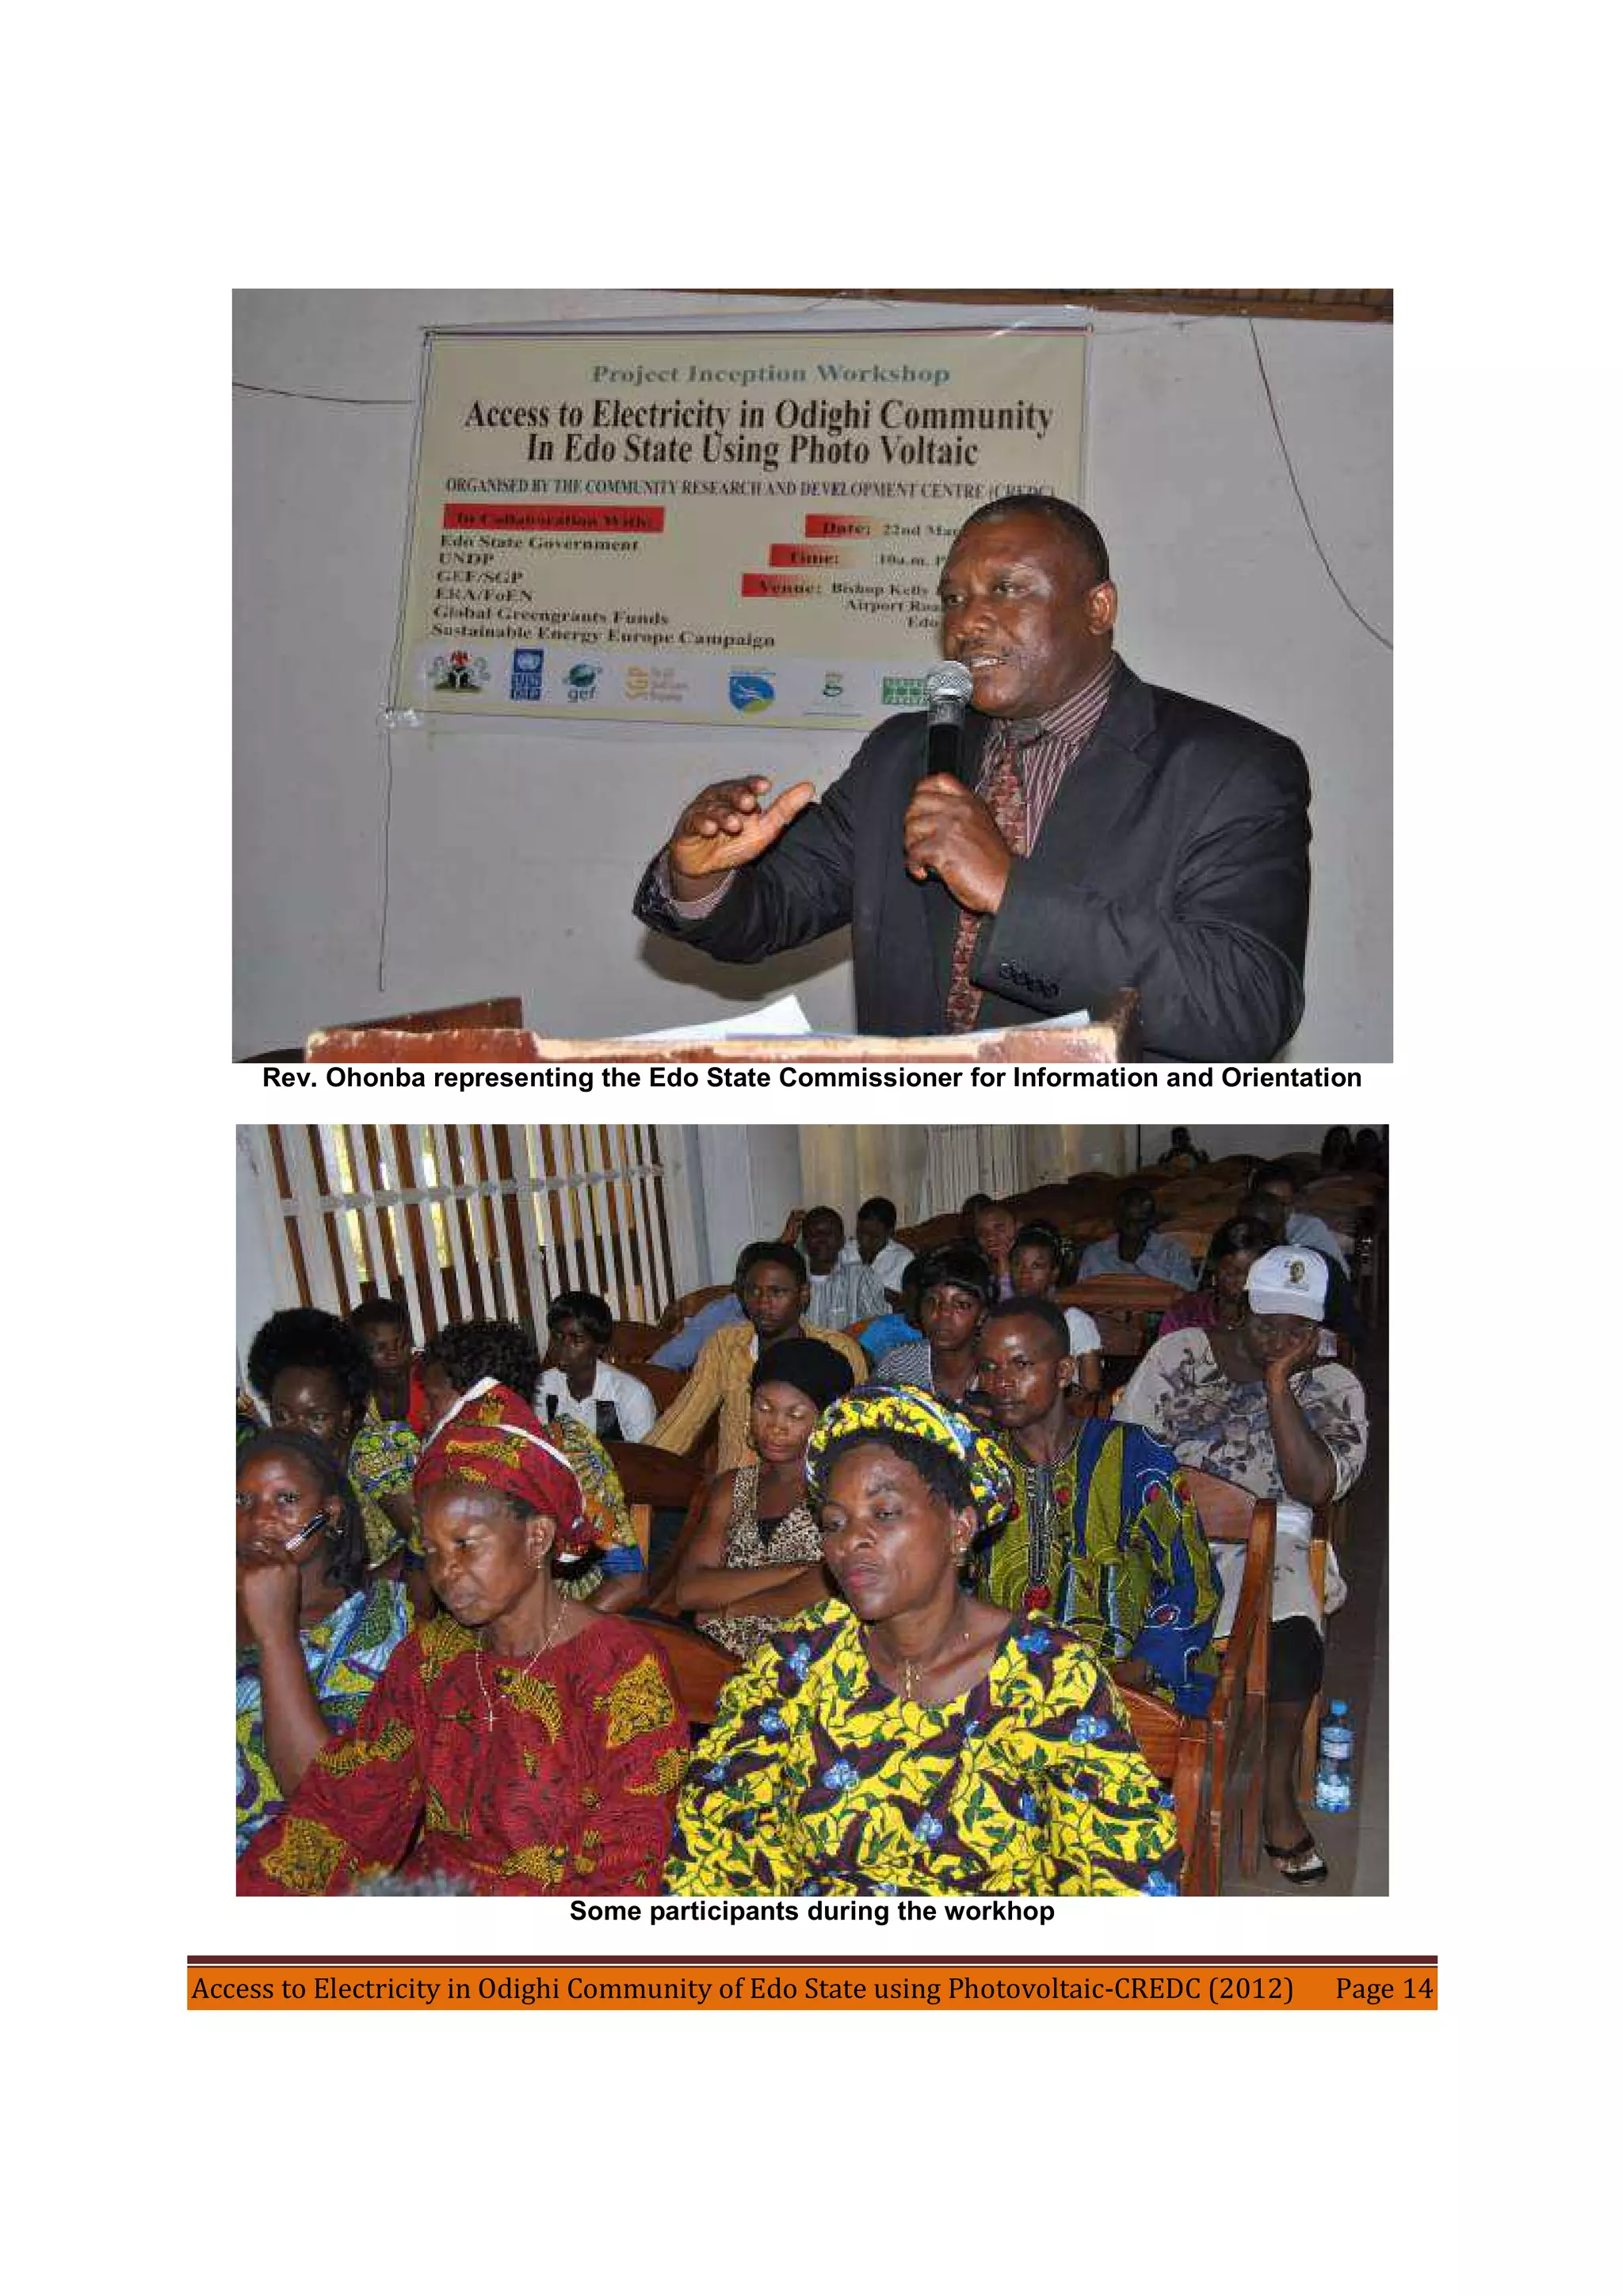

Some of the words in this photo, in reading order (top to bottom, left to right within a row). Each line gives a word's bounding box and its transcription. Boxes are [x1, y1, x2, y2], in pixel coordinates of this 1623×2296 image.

[593, 364, 678, 386] Project
[688, 364, 806, 387] Inception
[817, 364, 951, 387] Workshop
[464, 399, 548, 428] Access
[559, 401, 582, 428] to
[594, 399, 731, 435] Electricity
[739, 399, 764, 429] in
[776, 399, 870, 436] Odighi
[880, 399, 1052, 439] Community
[527, 433, 554, 460] In
[564, 433, 616, 463] Edo
[624, 433, 693, 463] State
[703, 435, 778, 471] Using
[791, 435, 869, 464] Photo
[881, 435, 980, 466] Voltaic
[445, 478, 528, 493] ORGANISED
[532, 478, 548, 493] BY
[554, 479, 582, 494] THE
[586, 479, 676, 494] COMMUNITY
[682, 480, 762, 496] RESEARCH
[764, 481, 796, 497] AND
[801, 481, 917, 499] DEVELOPMENT
[921, 482, 986, 499] CENTRE
[823, 521, 870, 536] Date:
[884, 524, 919, 536] 22nd
[441, 535, 475, 548] Edo
[478, 536, 522, 549] State
[529, 537, 639, 551] Government
[439, 552, 495, 565] UNDP
[791, 551, 840, 565] Time:
[437, 570, 524, 584] GEF/SGP
[437, 587, 533, 602] ERA/FoEN
[760, 579, 822, 594] Venue:
[832, 582, 884, 597] Bishop
[434, 606, 491, 621] Global
[498, 608, 606, 625] Greengrants
[613, 609, 669, 625] Funds
[849, 600, 903, 614] Airport
[908, 601, 943, 612] Roa
[432, 624, 529, 639] Sustainable
[538, 627, 598, 644] Energy
[608, 628, 674, 646] Europe
[679, 631, 775, 649] Campaign
[567, 686, 596, 704] gef
[263, 1066, 317, 1088] Rev.
[326, 1066, 426, 1088] Ohonba
[434, 1066, 594, 1093] representing
[601, 1066, 641, 1088] the
[650, 1066, 699, 1088] Edo
[707, 1066, 771, 1088] State
[779, 1066, 964, 1088] Commissioner
[970, 1066, 1006, 1088] for
[1014, 1066, 1158, 1088] Information
[1167, 1066, 1213, 1088] and
[1222, 1066, 1361, 1088] Orientation
[570, 1900, 641, 1920] Some
[651, 1900, 799, 1926] participants
[808, 1900, 889, 1926] during
[897, 1900, 937, 1920] the
[944, 1900, 1055, 1926] workhop
[191, 1978, 273, 1999] Access
[281, 1980, 306, 1999] to
[314, 1977, 441, 2005] Electricity
[448, 1978, 471, 1999] in
[479, 1977, 559, 2005] Odighi
[567, 1978, 712, 2005] Community
[719, 1977, 746, 1999] of
[750, 1977, 797, 1999] Edo
[805, 1978, 866, 1999] State
[874, 1978, 941, 2005] using
[949, 1977, 1201, 1999] Photovoltaic-CREDC
[1209, 1977, 1293, 2005] (2012)
[1337, 1978, 1394, 2005] Page
[1403, 1978, 1434, 1999] 14
